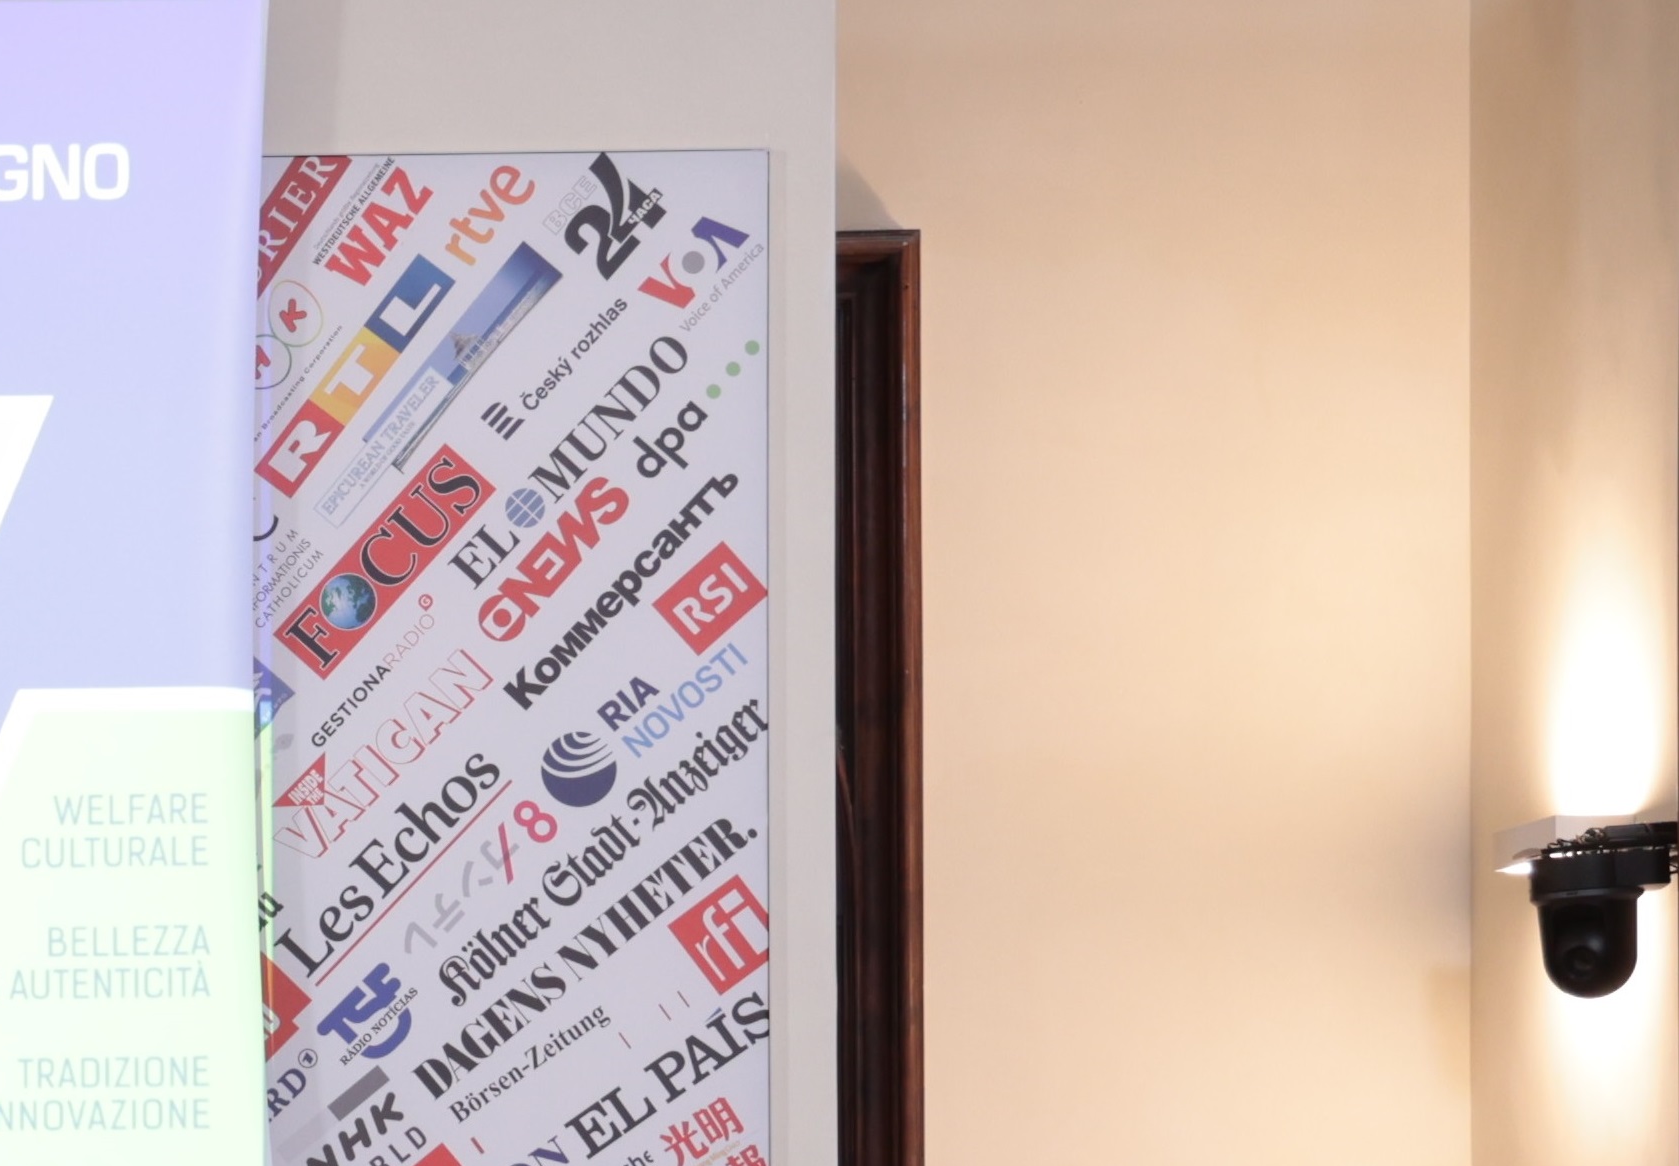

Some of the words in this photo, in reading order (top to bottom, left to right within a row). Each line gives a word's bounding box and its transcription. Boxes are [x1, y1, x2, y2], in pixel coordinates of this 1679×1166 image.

[324, 166, 435, 288] WAZ
[444, 164, 537, 267] rtve
[568, 296, 629, 359] rozhlas
[528, 335, 690, 504] MUNDO
[635, 400, 708, 479] dpa
[502, 472, 739, 711] Коммерсантъ
[671, 561, 751, 636] RSI
[596, 675, 661, 733] RIA
[620, 642, 750, 759] NOVOSTI
[53, 792, 210, 828] WELFARE
[20, 835, 210, 870] CULTURALE
[273, 885, 377, 979] Les
[348, 752, 503, 900] Echos
[9, 960, 212, 1001] AUTENTICITÀ
[47, 924, 212, 958] BELLEZZA
[412, 966, 568, 1101] DAGENS
[556, 817, 759, 983] NYHETER.
[17, 1055, 211, 1090] TRADIZIONE
[448, 1004, 611, 1123] Börsen-Zeitung
